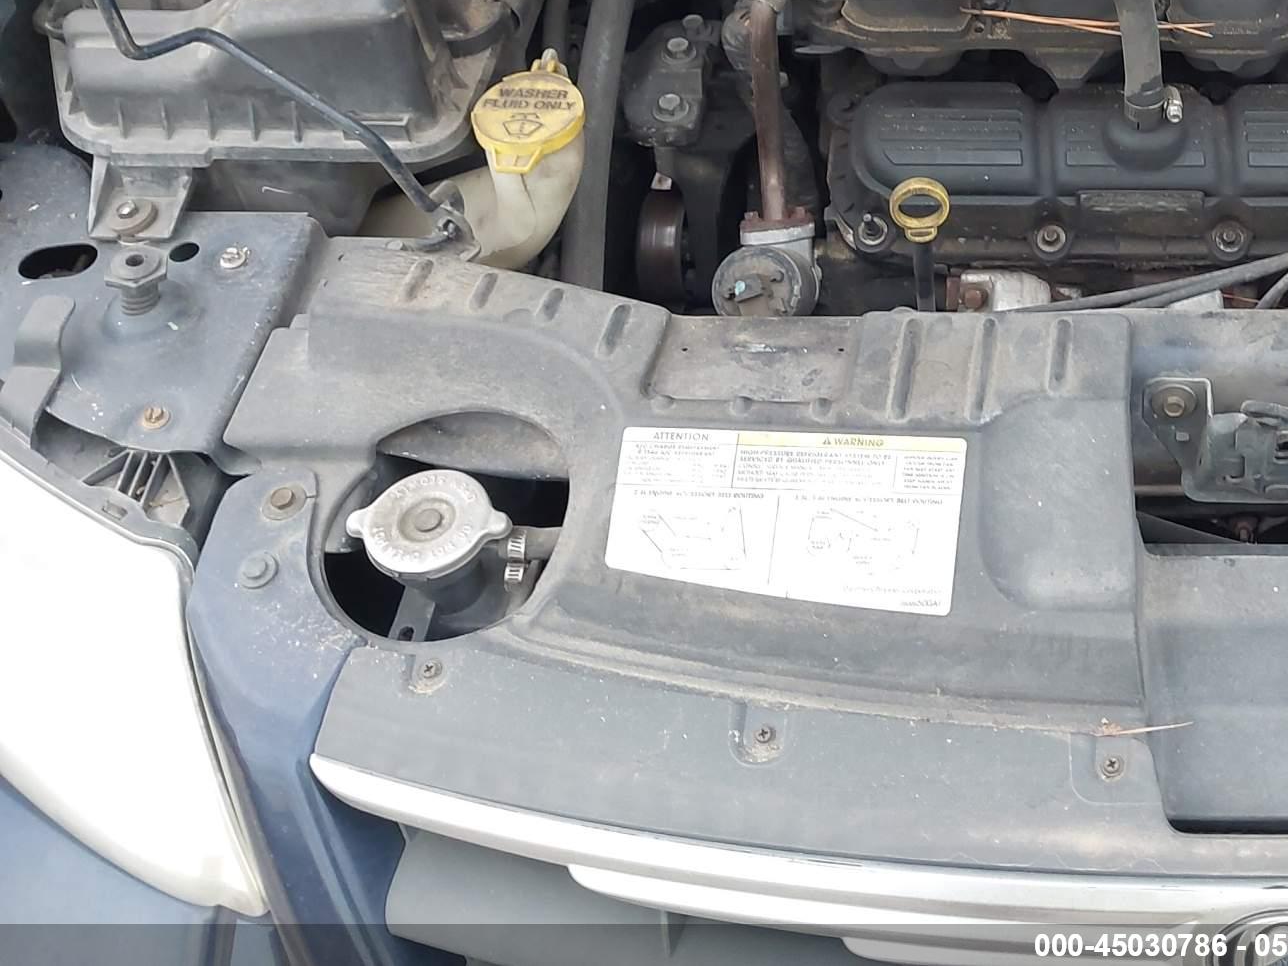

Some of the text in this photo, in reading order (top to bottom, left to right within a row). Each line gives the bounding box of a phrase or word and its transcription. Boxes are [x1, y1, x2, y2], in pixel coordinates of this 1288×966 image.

[499, 88, 568, 99] WASHER
[482, 99, 576, 110] FLUID ONLY
[653, 431, 709, 441] ATTENTION
[834, 438, 885, 447] WARNING
